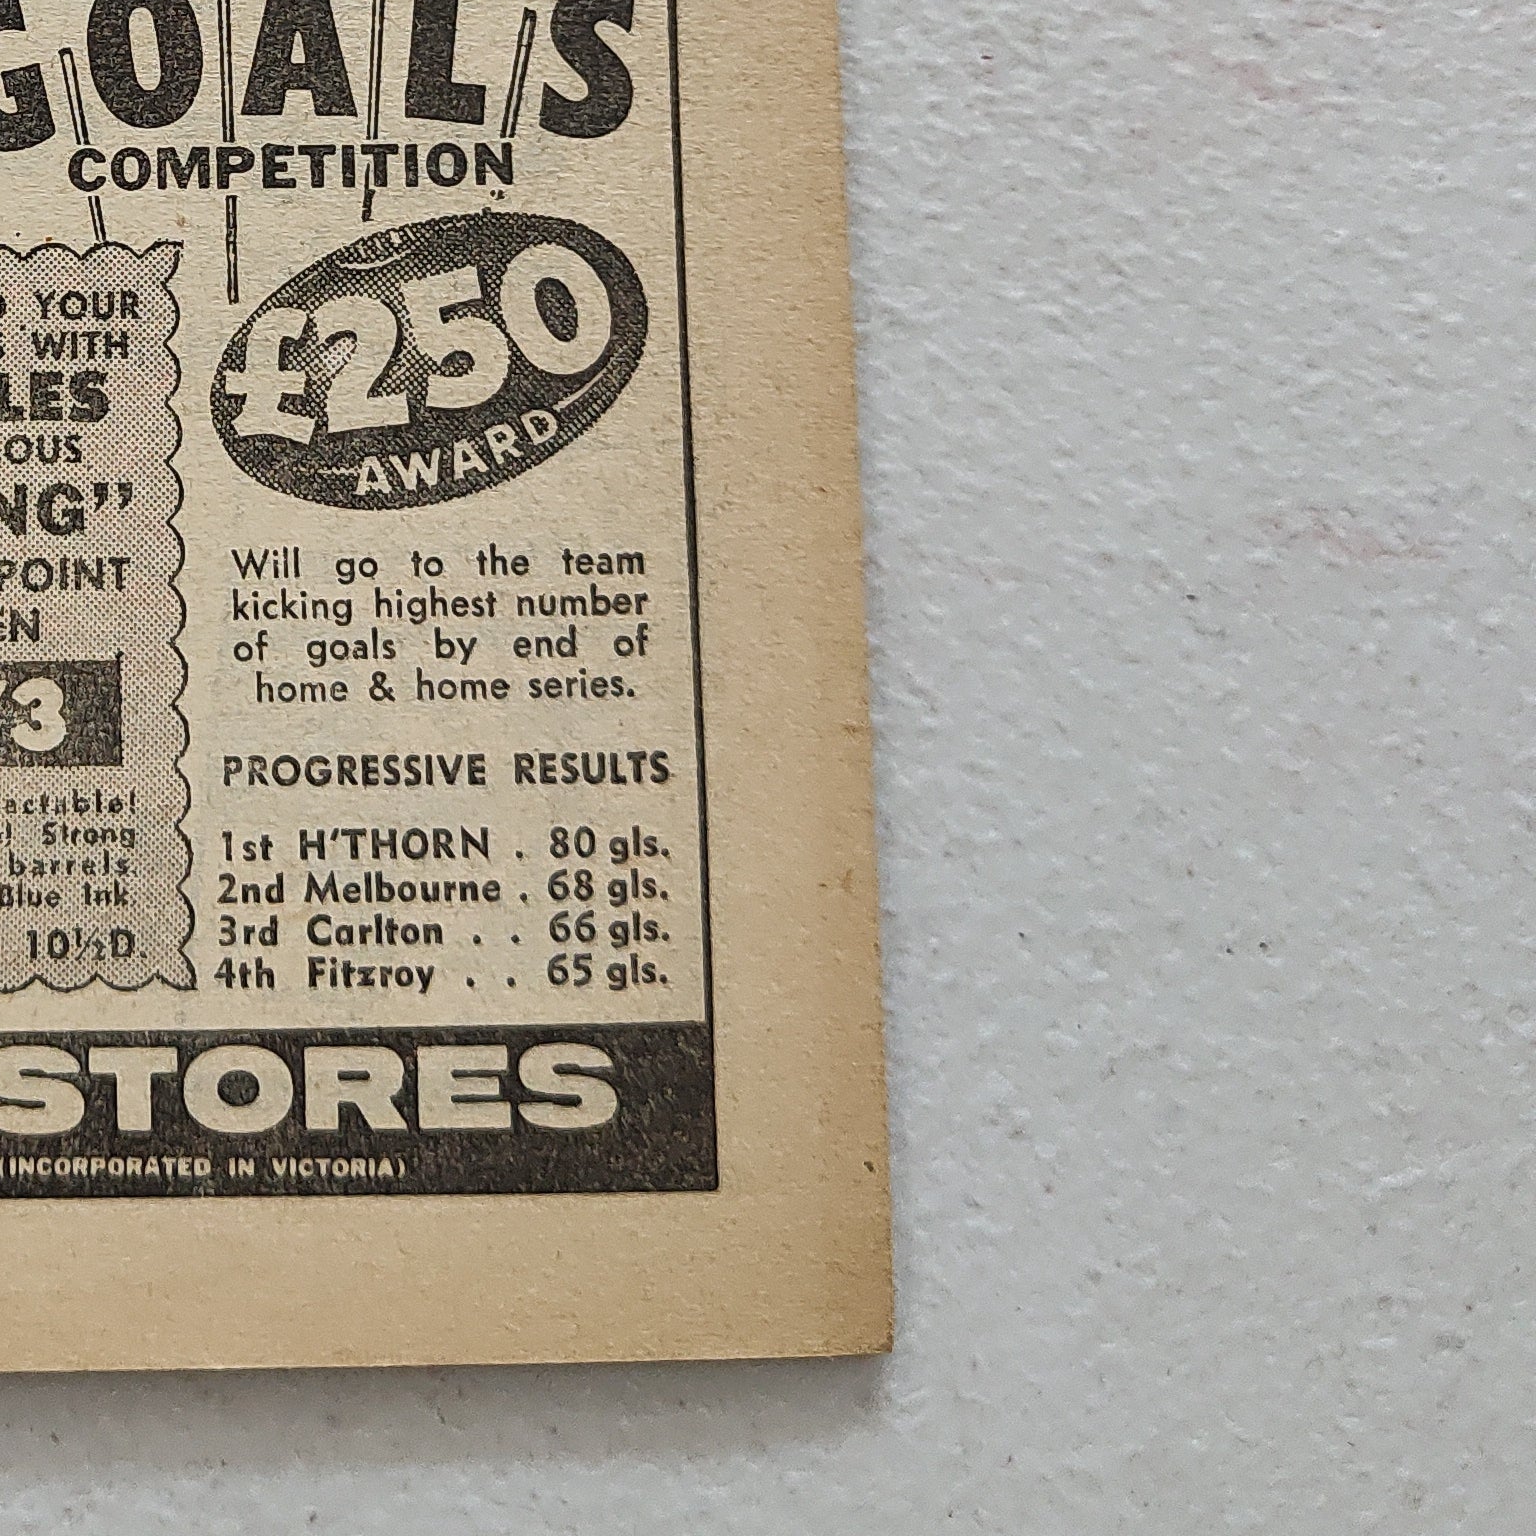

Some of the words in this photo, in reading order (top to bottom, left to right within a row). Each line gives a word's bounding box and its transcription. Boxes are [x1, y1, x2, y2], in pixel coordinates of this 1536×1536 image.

[68, 141, 515, 194] COMPETITION
[35, 289, 140, 320] YOUR
[32, 331, 129, 360] WITH
[224, 242, 613, 446] £250
[355, 408, 560, 497] AWARD
[231, 547, 300, 580] Will
[335, 555, 379, 584] go
[411, 550, 443, 577] to
[477, 543, 530, 576] the
[563, 548, 646, 575] team
[232, 588, 354, 626] kicking
[375, 587, 497, 624] highest
[516, 583, 649, 617] number
[233, 630, 268, 663] of
[306, 628, 397, 668] goals
[435, 626, 478, 665] by
[512, 625, 578, 658] end
[614, 623, 649, 657] of
[256, 670, 349, 703] home
[369, 671, 396, 701] &
[417, 667, 511, 701] home
[528, 666, 635, 700] series.
[223, 753, 487, 788] PROGRESSIVE
[514, 750, 672, 786] RESULTS
[42, 821, 136, 848] Strong
[221, 831, 273, 862] 1st
[299, 826, 490, 861] H'THORN
[549, 826, 596, 858] 80
[608, 825, 671, 863] gls.
[217, 872, 284, 905] 2nd
[304, 871, 500, 904] Melbourne
[547, 869, 594, 902] 68
[608, 868, 668, 906] gls.
[218, 915, 279, 947] 3rd
[306, 914, 443, 947] Carlton
[549, 911, 596, 944] 66
[608, 909, 670, 948] gls.
[214, 957, 275, 990] 4th
[307, 955, 435, 994] Fitzroy
[547, 953, 593, 987] 65
[606, 951, 668, 991] gls.
[227, 1156, 255, 1177] IN
[272, 1156, 407, 1178] VICTORIA)
